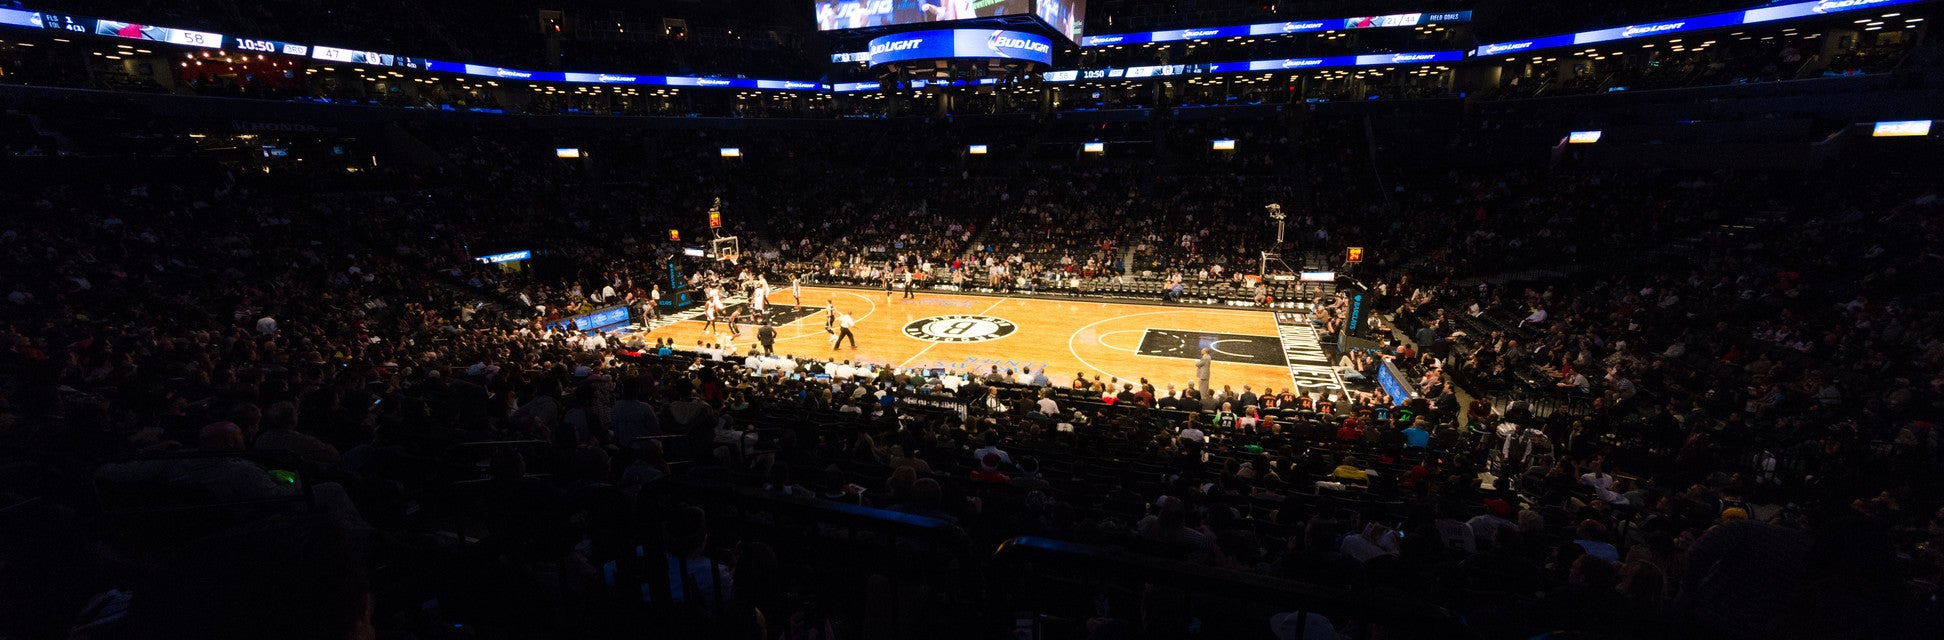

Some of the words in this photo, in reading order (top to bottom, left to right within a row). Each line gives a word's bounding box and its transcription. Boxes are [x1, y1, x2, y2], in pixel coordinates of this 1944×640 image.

[1651, 22, 1685, 32] LIGHT
[184, 32, 204, 44] 58
[236, 38, 275, 52] 10:50
[885, 38, 923, 53] LIGHT
[995, 36, 1024, 49] BUD
[1025, 39, 1050, 53] LIGHT
[1508, 41, 1532, 49] LIGHT
[326, 49, 339, 58] 47
[1059, 72, 1070, 80] 58
[1083, 70, 1104, 79] 10:50
[498, 251, 528, 262] LIGHT
[1349, 301, 1360, 331] BARCLAYS
[1290, 363, 1342, 390] NETS
